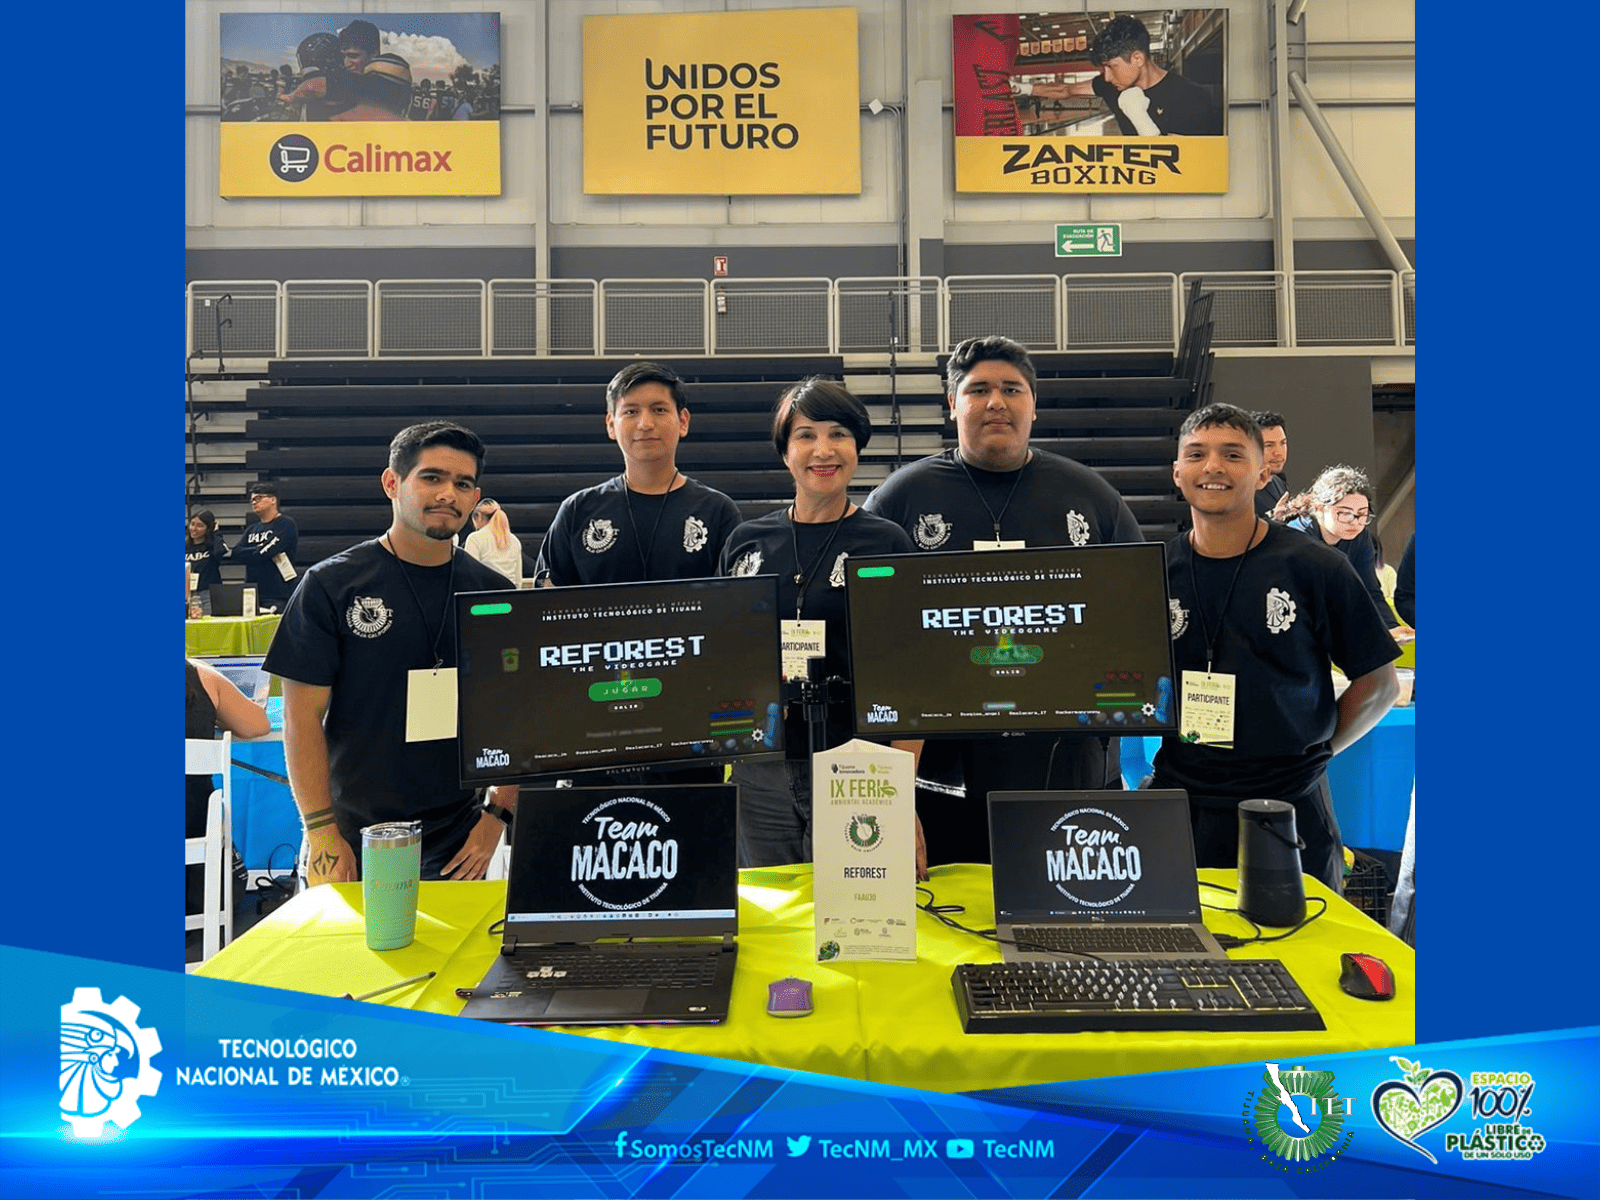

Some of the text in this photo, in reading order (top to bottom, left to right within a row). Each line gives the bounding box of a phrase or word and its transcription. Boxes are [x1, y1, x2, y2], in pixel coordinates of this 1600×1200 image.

[645, 57, 780, 90] UNIDOS
[646, 93, 778, 120] POR EL
[646, 123, 799, 149] FUTURO
[324, 143, 452, 173] Calimax
[1002, 144, 1182, 175] ZANFER
[1030, 165, 1157, 185] BOXING
[923, 577, 967, 585] INSTITUTO
[971, 574, 1031, 582] TECNOLÓGICO
[542, 612, 589, 621] INSTITUTO
[593, 608, 653, 618] TECNOLÓGICO
[922, 603, 1087, 629] REFOREST
[984, 627, 1059, 635] VIDEOGAME
[540, 635, 705, 667] REFOREST
[782, 641, 820, 652] ARTICIPANTE
[604, 659, 677, 670] VIDEOGAME
[603, 685, 648, 695] JUGAR
[1187, 692, 1230, 706] PARTICIPANTE
[476, 753, 510, 769] MACACO
[831, 779, 845, 798] IX
[582, 799, 617, 824] TECNOLÓGICO
[618, 797, 646, 805] NACIONAL
[646, 801, 654, 809] DE
[594, 817, 659, 840] Team
[1061, 825, 1120, 846] Team
[571, 839, 678, 882] MACACO
[1046, 845, 1142, 882] MACACO
[844, 867, 887, 879] REFOREST
[578, 883, 602, 906] INSTITUTO
[642, 897, 651, 905] DE
